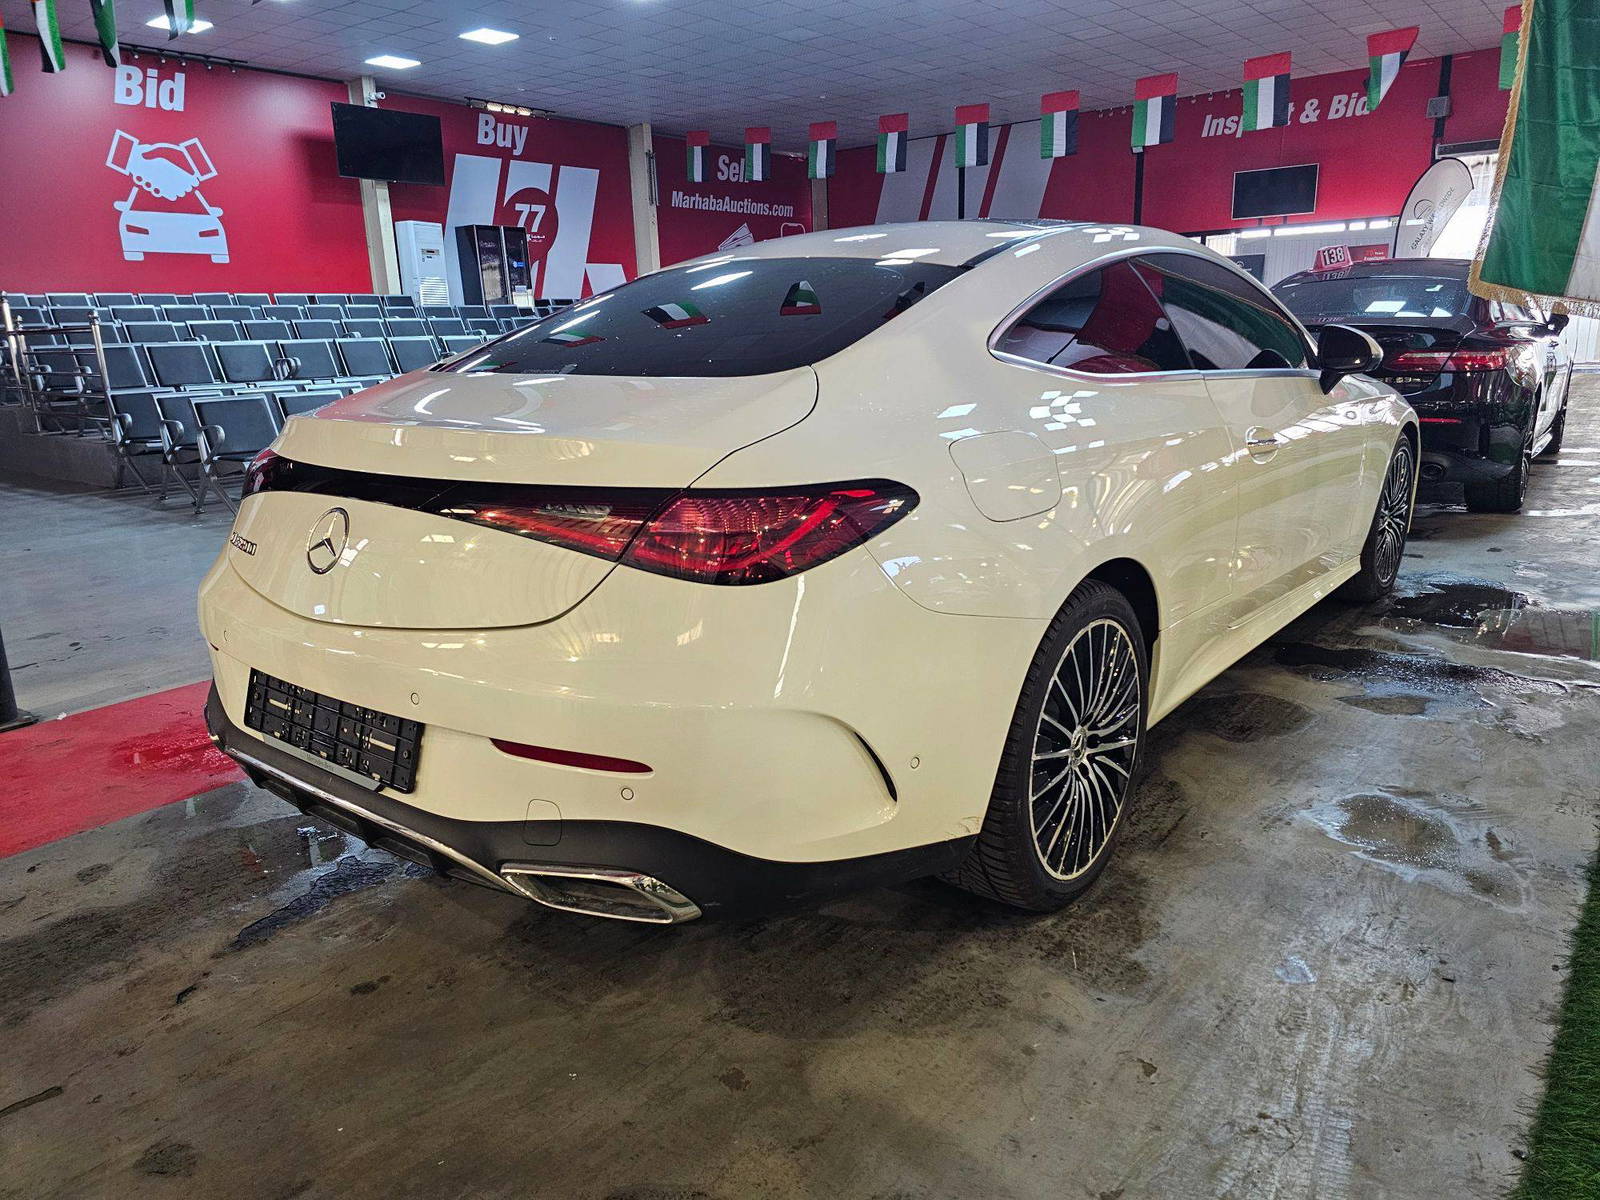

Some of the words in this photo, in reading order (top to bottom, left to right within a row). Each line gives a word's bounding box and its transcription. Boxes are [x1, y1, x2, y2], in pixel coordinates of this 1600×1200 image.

[114, 64, 185, 112] Bid
[1300, 98, 1320, 124] &
[477, 113, 529, 156] Buy
[717, 154, 748, 183] Sel
[515, 203, 546, 232] 77
[671, 190, 794, 217] MarhabaAuctions.com
[1323, 247, 1344, 265] 138
